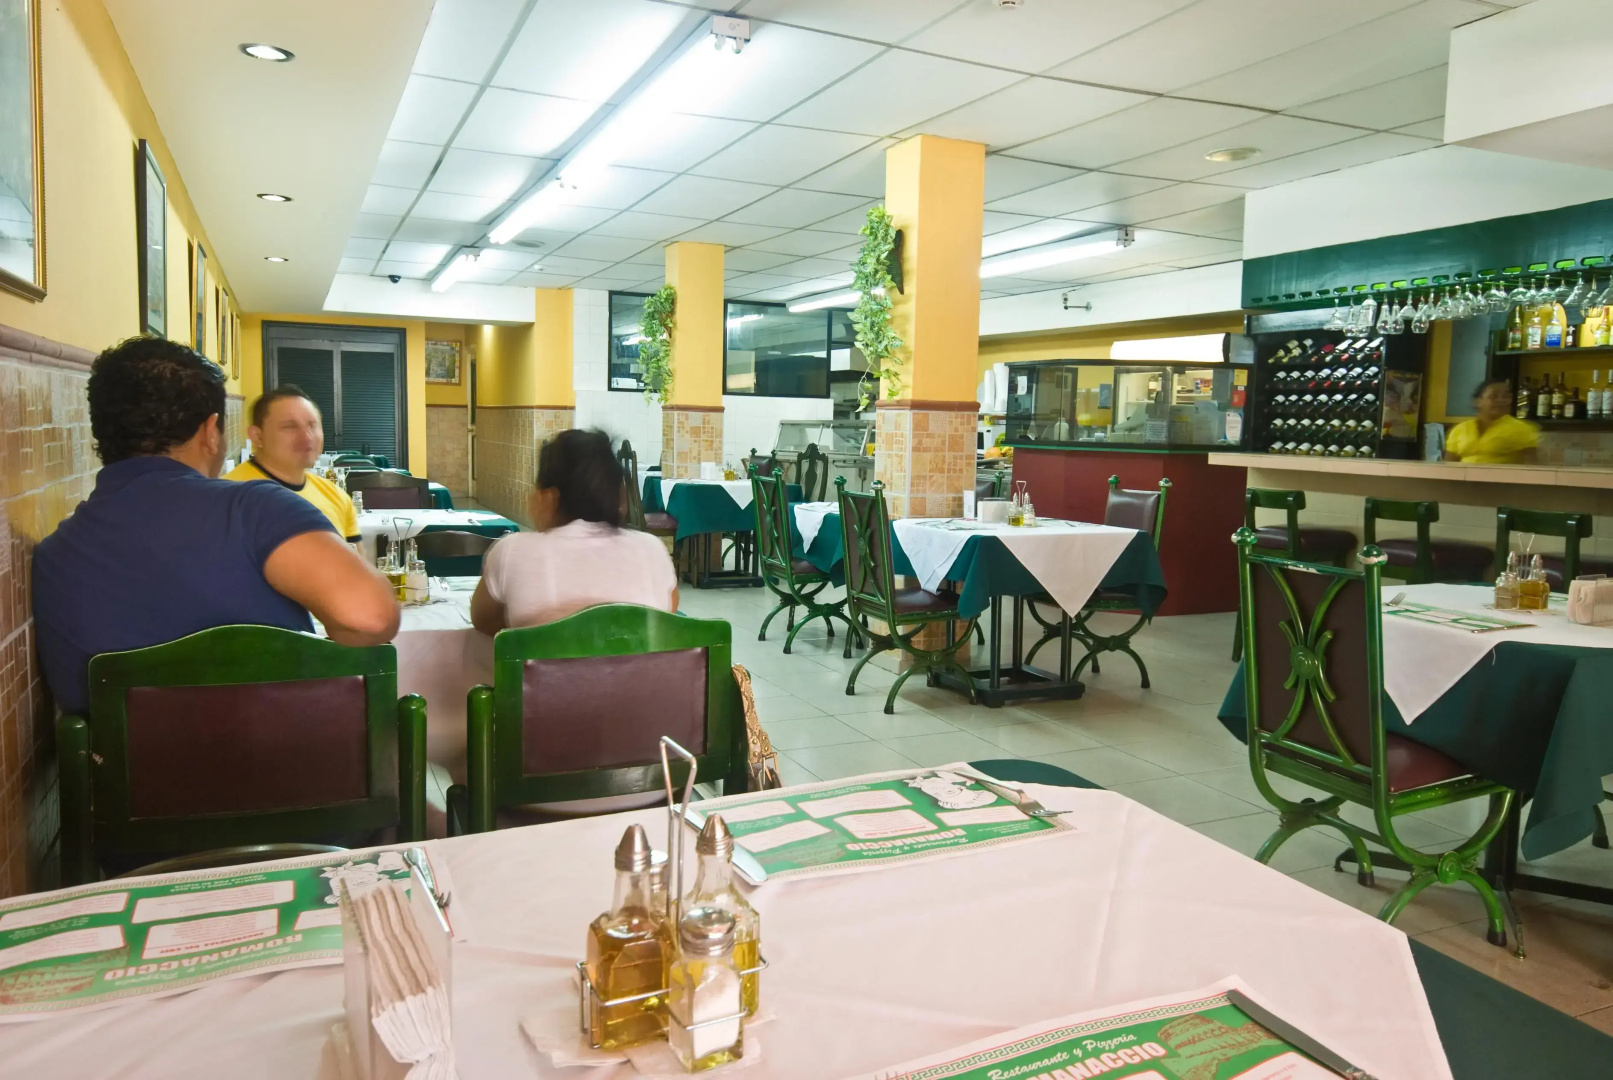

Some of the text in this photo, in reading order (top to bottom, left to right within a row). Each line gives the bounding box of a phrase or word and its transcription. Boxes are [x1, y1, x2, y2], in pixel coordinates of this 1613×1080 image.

[844, 828, 968, 850] ROMANACCIO
[103, 933, 302, 980] ROMANACCIO
[987, 1051, 1070, 1080] Restaurante
[1073, 1047, 1083, 1058] y
